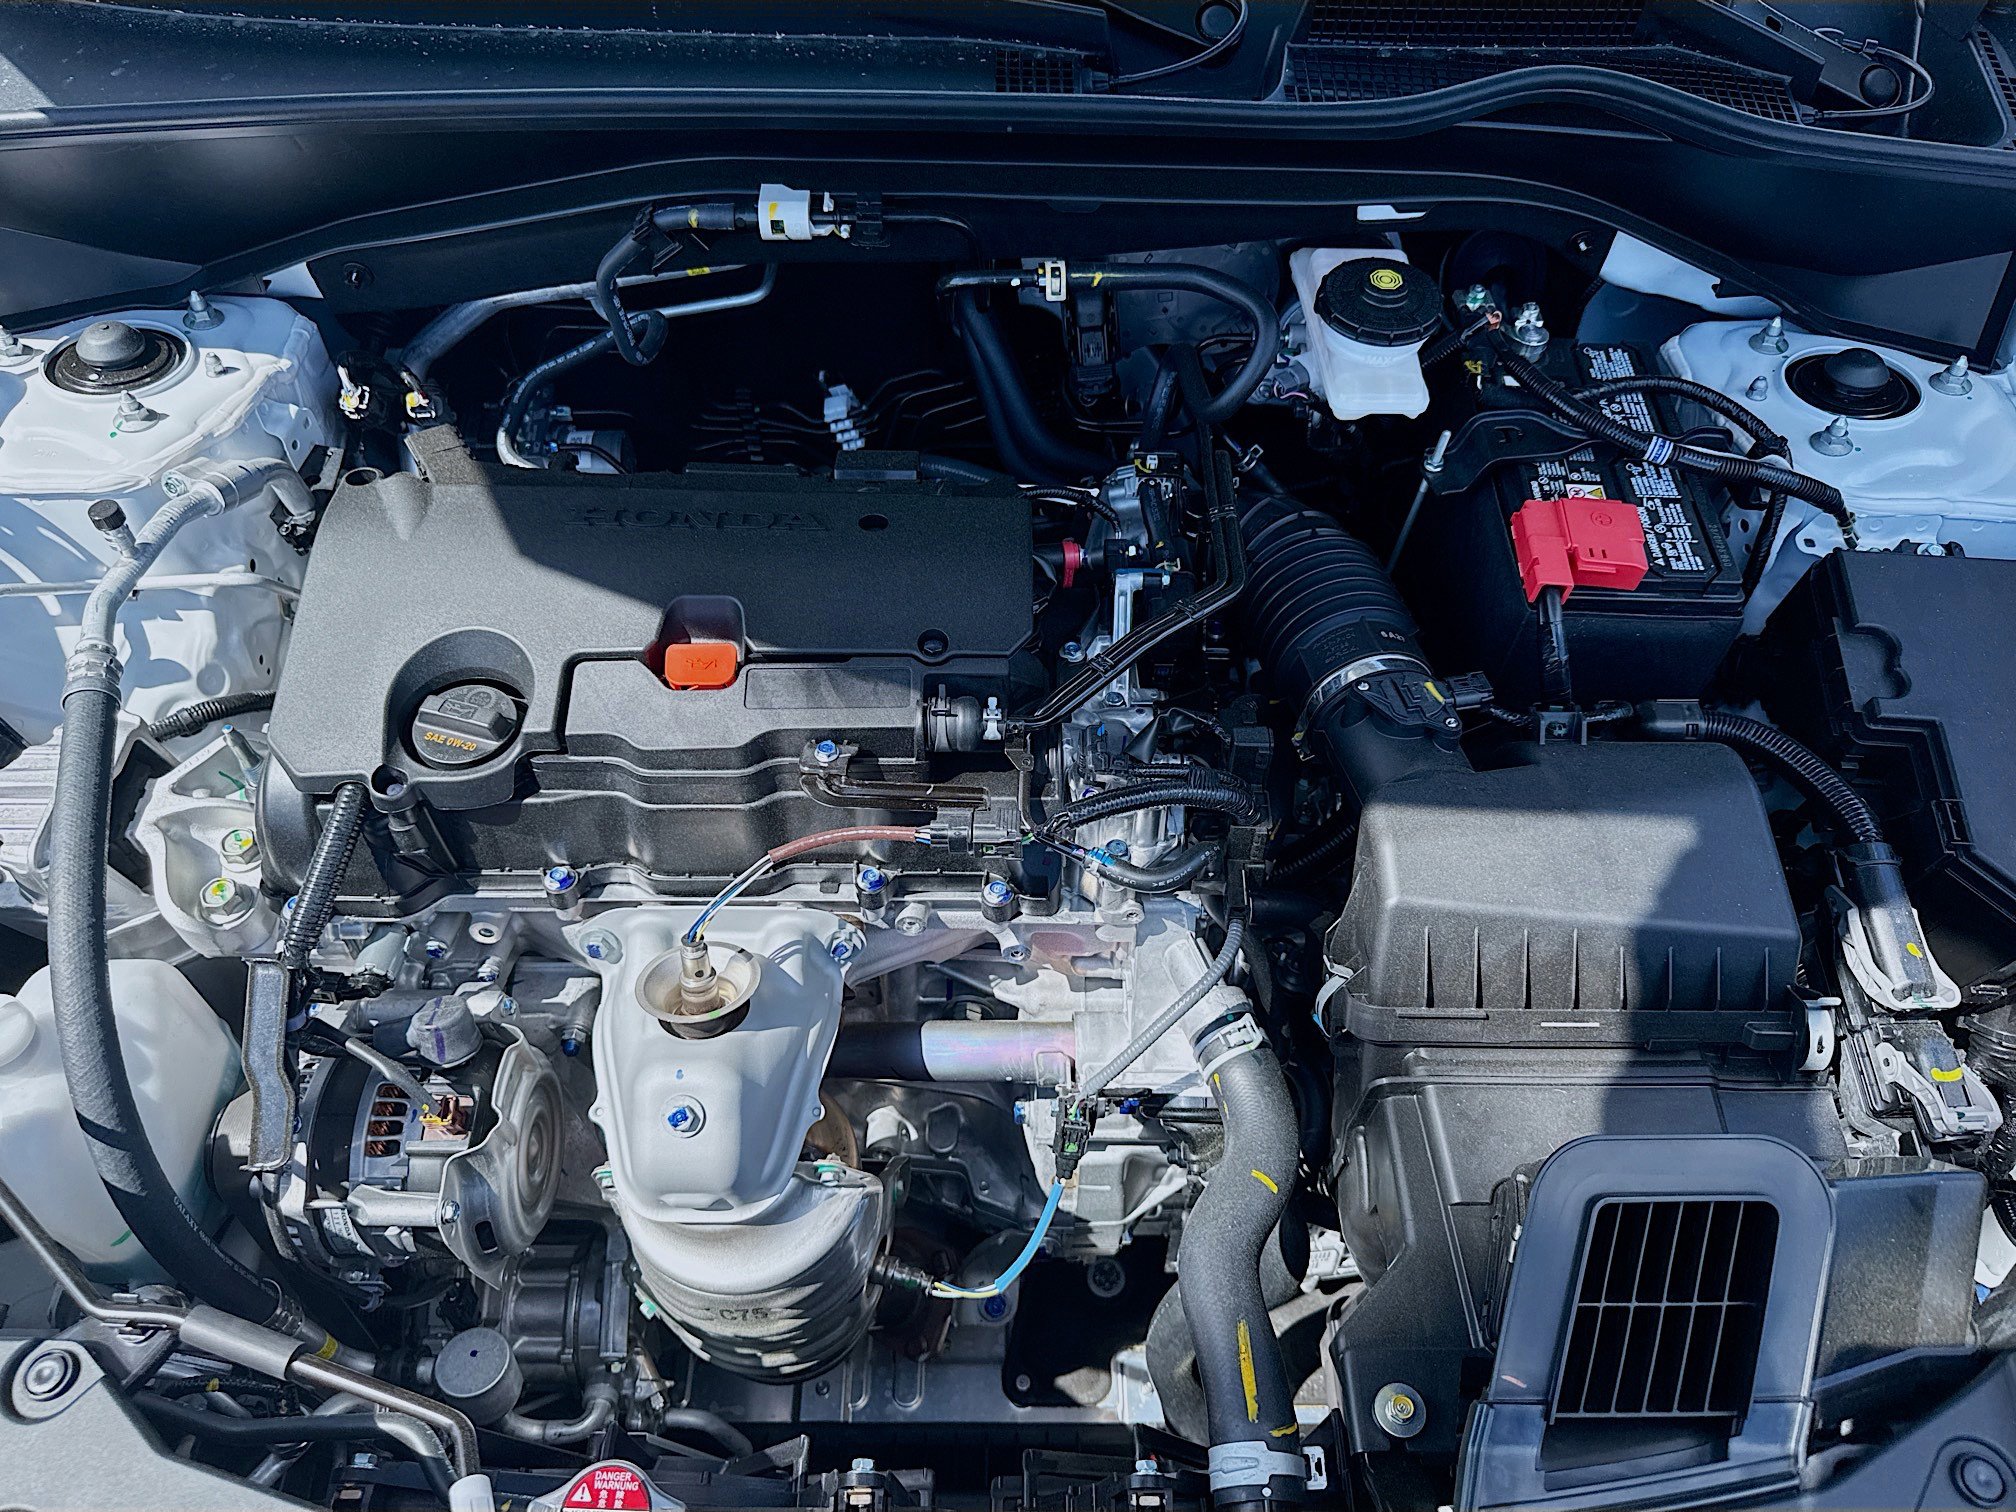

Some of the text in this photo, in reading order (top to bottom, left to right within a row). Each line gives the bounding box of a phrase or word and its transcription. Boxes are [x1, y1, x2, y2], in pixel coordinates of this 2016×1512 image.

[564, 508, 830, 531] HONDA
[424, 731, 477, 752] SAE 0W-20
[173, 1195, 198, 1232] GALAXY
[594, 1480, 639, 1491] WARNUNG
[595, 1471, 632, 1481] DANGER
